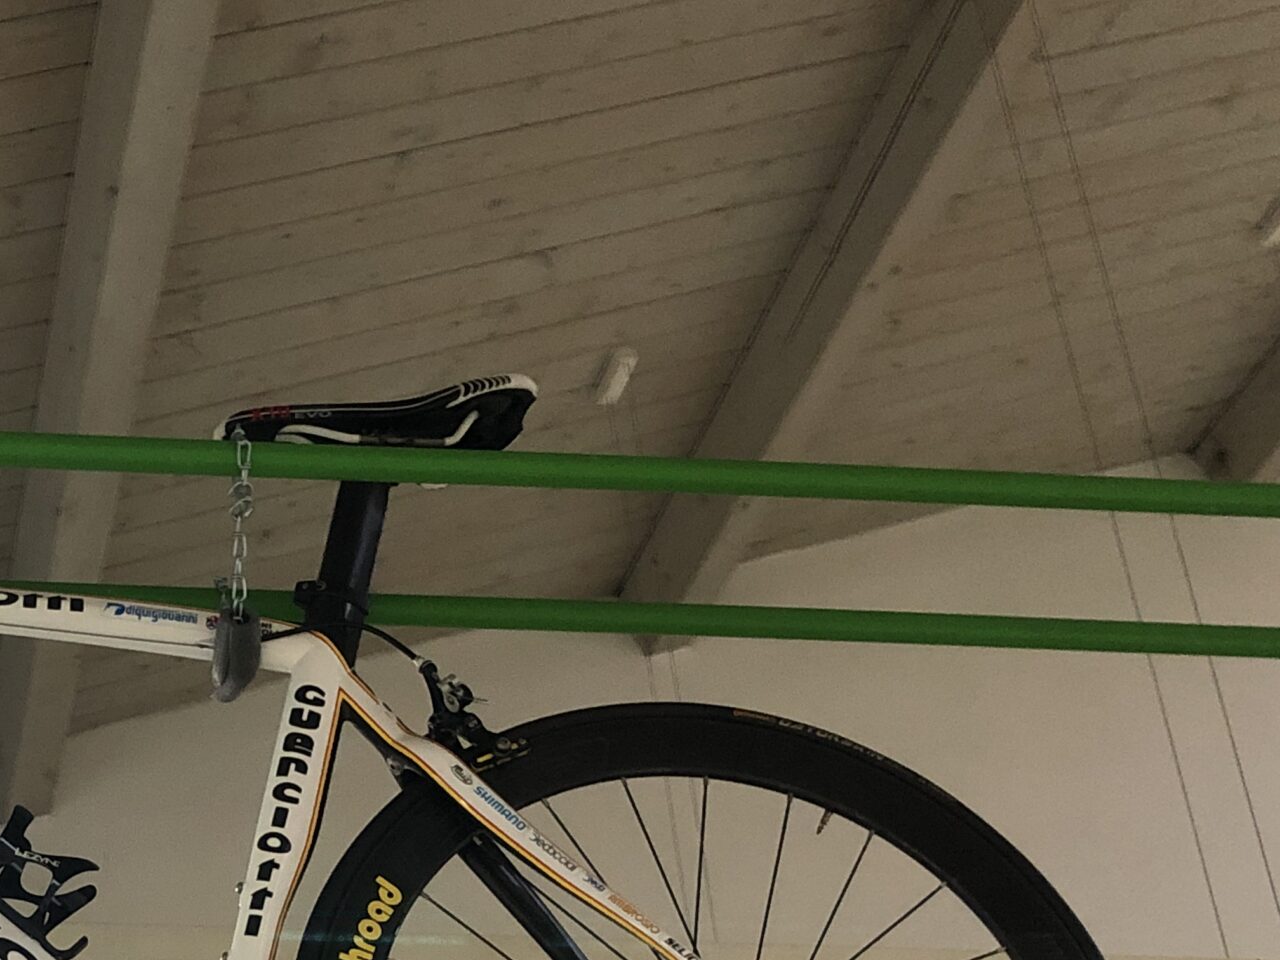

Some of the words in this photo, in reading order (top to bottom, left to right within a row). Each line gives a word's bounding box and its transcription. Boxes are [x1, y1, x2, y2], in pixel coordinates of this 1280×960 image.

[244, 684, 326, 937] Guerciotti
[473, 786, 527, 831] SHIMANO
[608, 894, 660, 934] AMBROSIO
